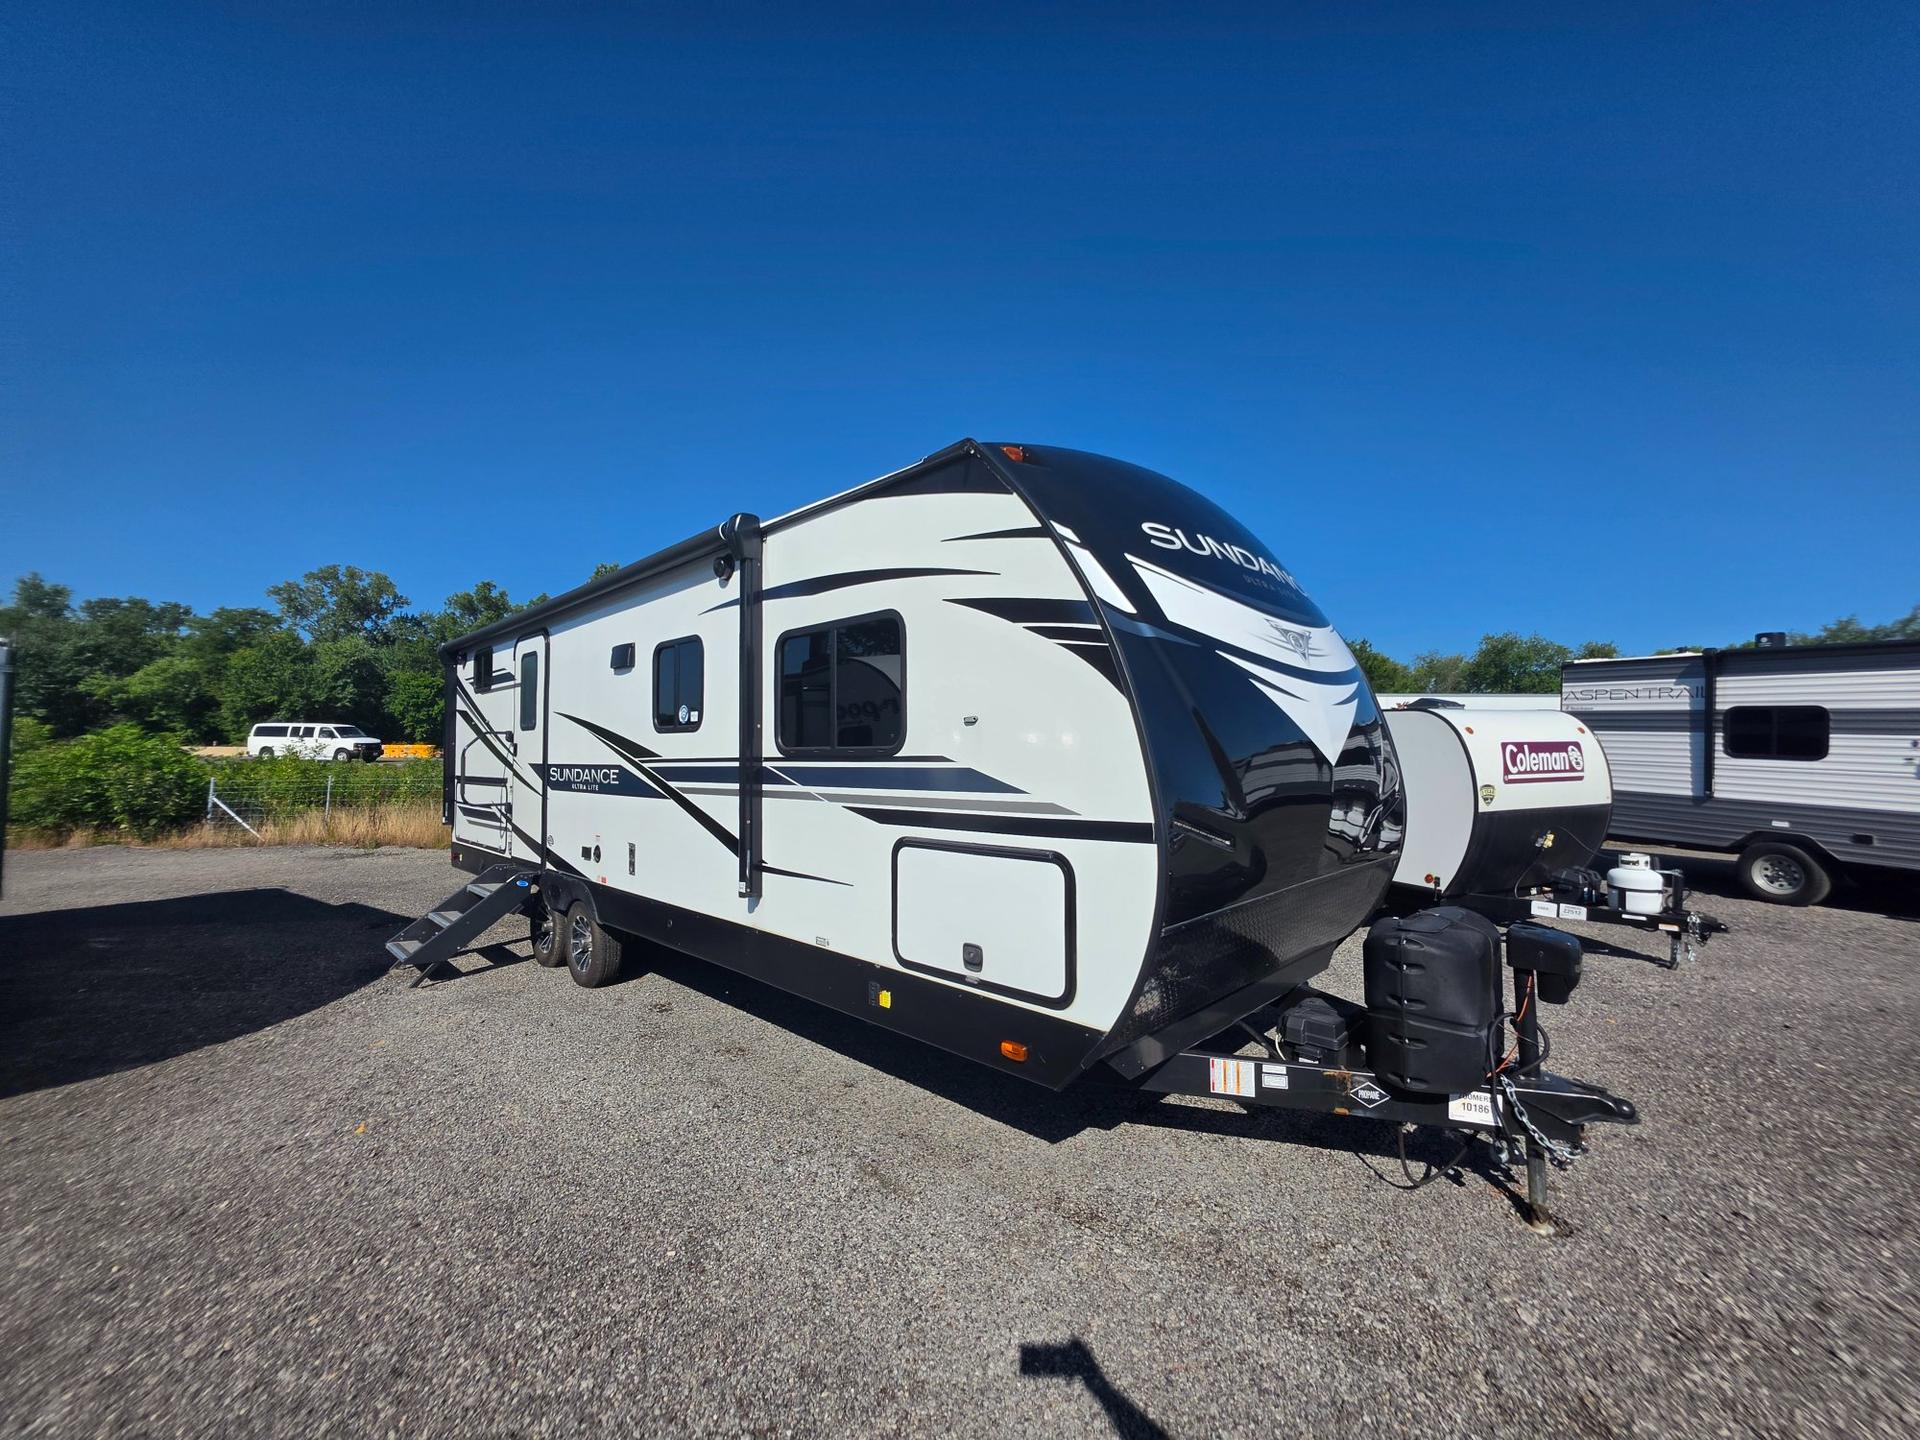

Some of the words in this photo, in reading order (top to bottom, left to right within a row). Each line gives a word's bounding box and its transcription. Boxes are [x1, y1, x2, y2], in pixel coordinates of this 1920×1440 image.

[1141, 522, 1309, 597] SUNDANC
[1564, 688, 1639, 701] ASPEN
[1642, 686, 1706, 699] TRAIL
[1505, 744, 1570, 774] Coleman
[549, 767, 620, 784] SUNDANCE
[1357, 1089, 1380, 1100] PROPANE
[1462, 1102, 1490, 1114] 10186
